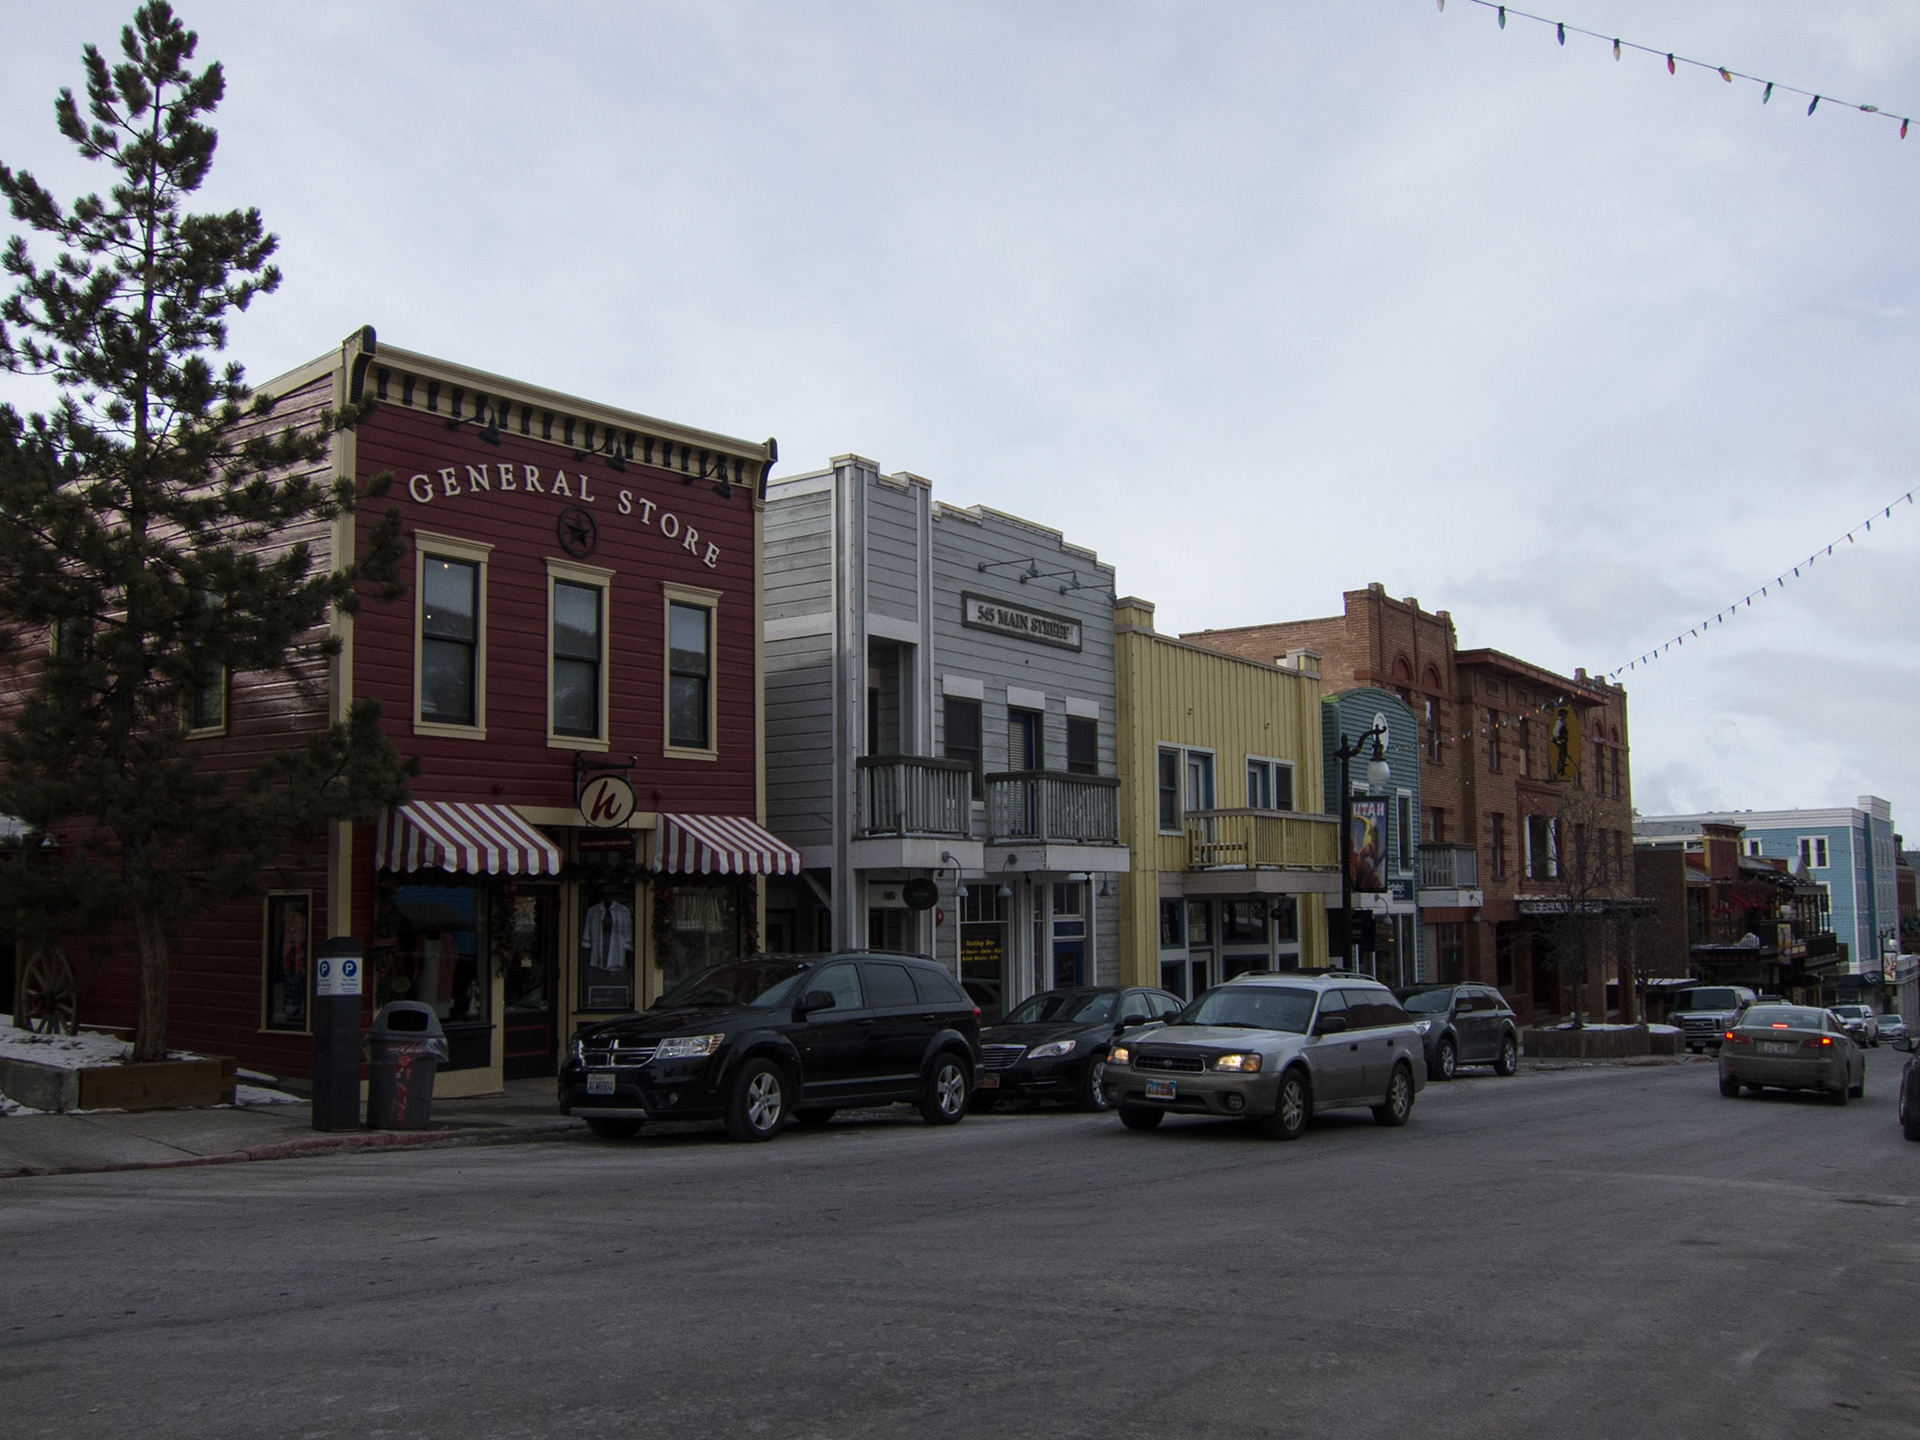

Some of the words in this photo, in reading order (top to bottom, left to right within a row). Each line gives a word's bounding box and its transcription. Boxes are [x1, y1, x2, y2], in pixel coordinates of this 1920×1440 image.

[408, 463, 595, 503] GENERAL
[617, 489, 720, 569] STORE
[977, 605, 995, 622] 545
[997, 608, 1028, 630] MAIN
[1031, 617, 1070, 640] STREET
[590, 779, 622, 821] h
[1353, 802, 1384, 816] UTAH
[321, 963, 328, 974] P
[345, 963, 354, 974] P
